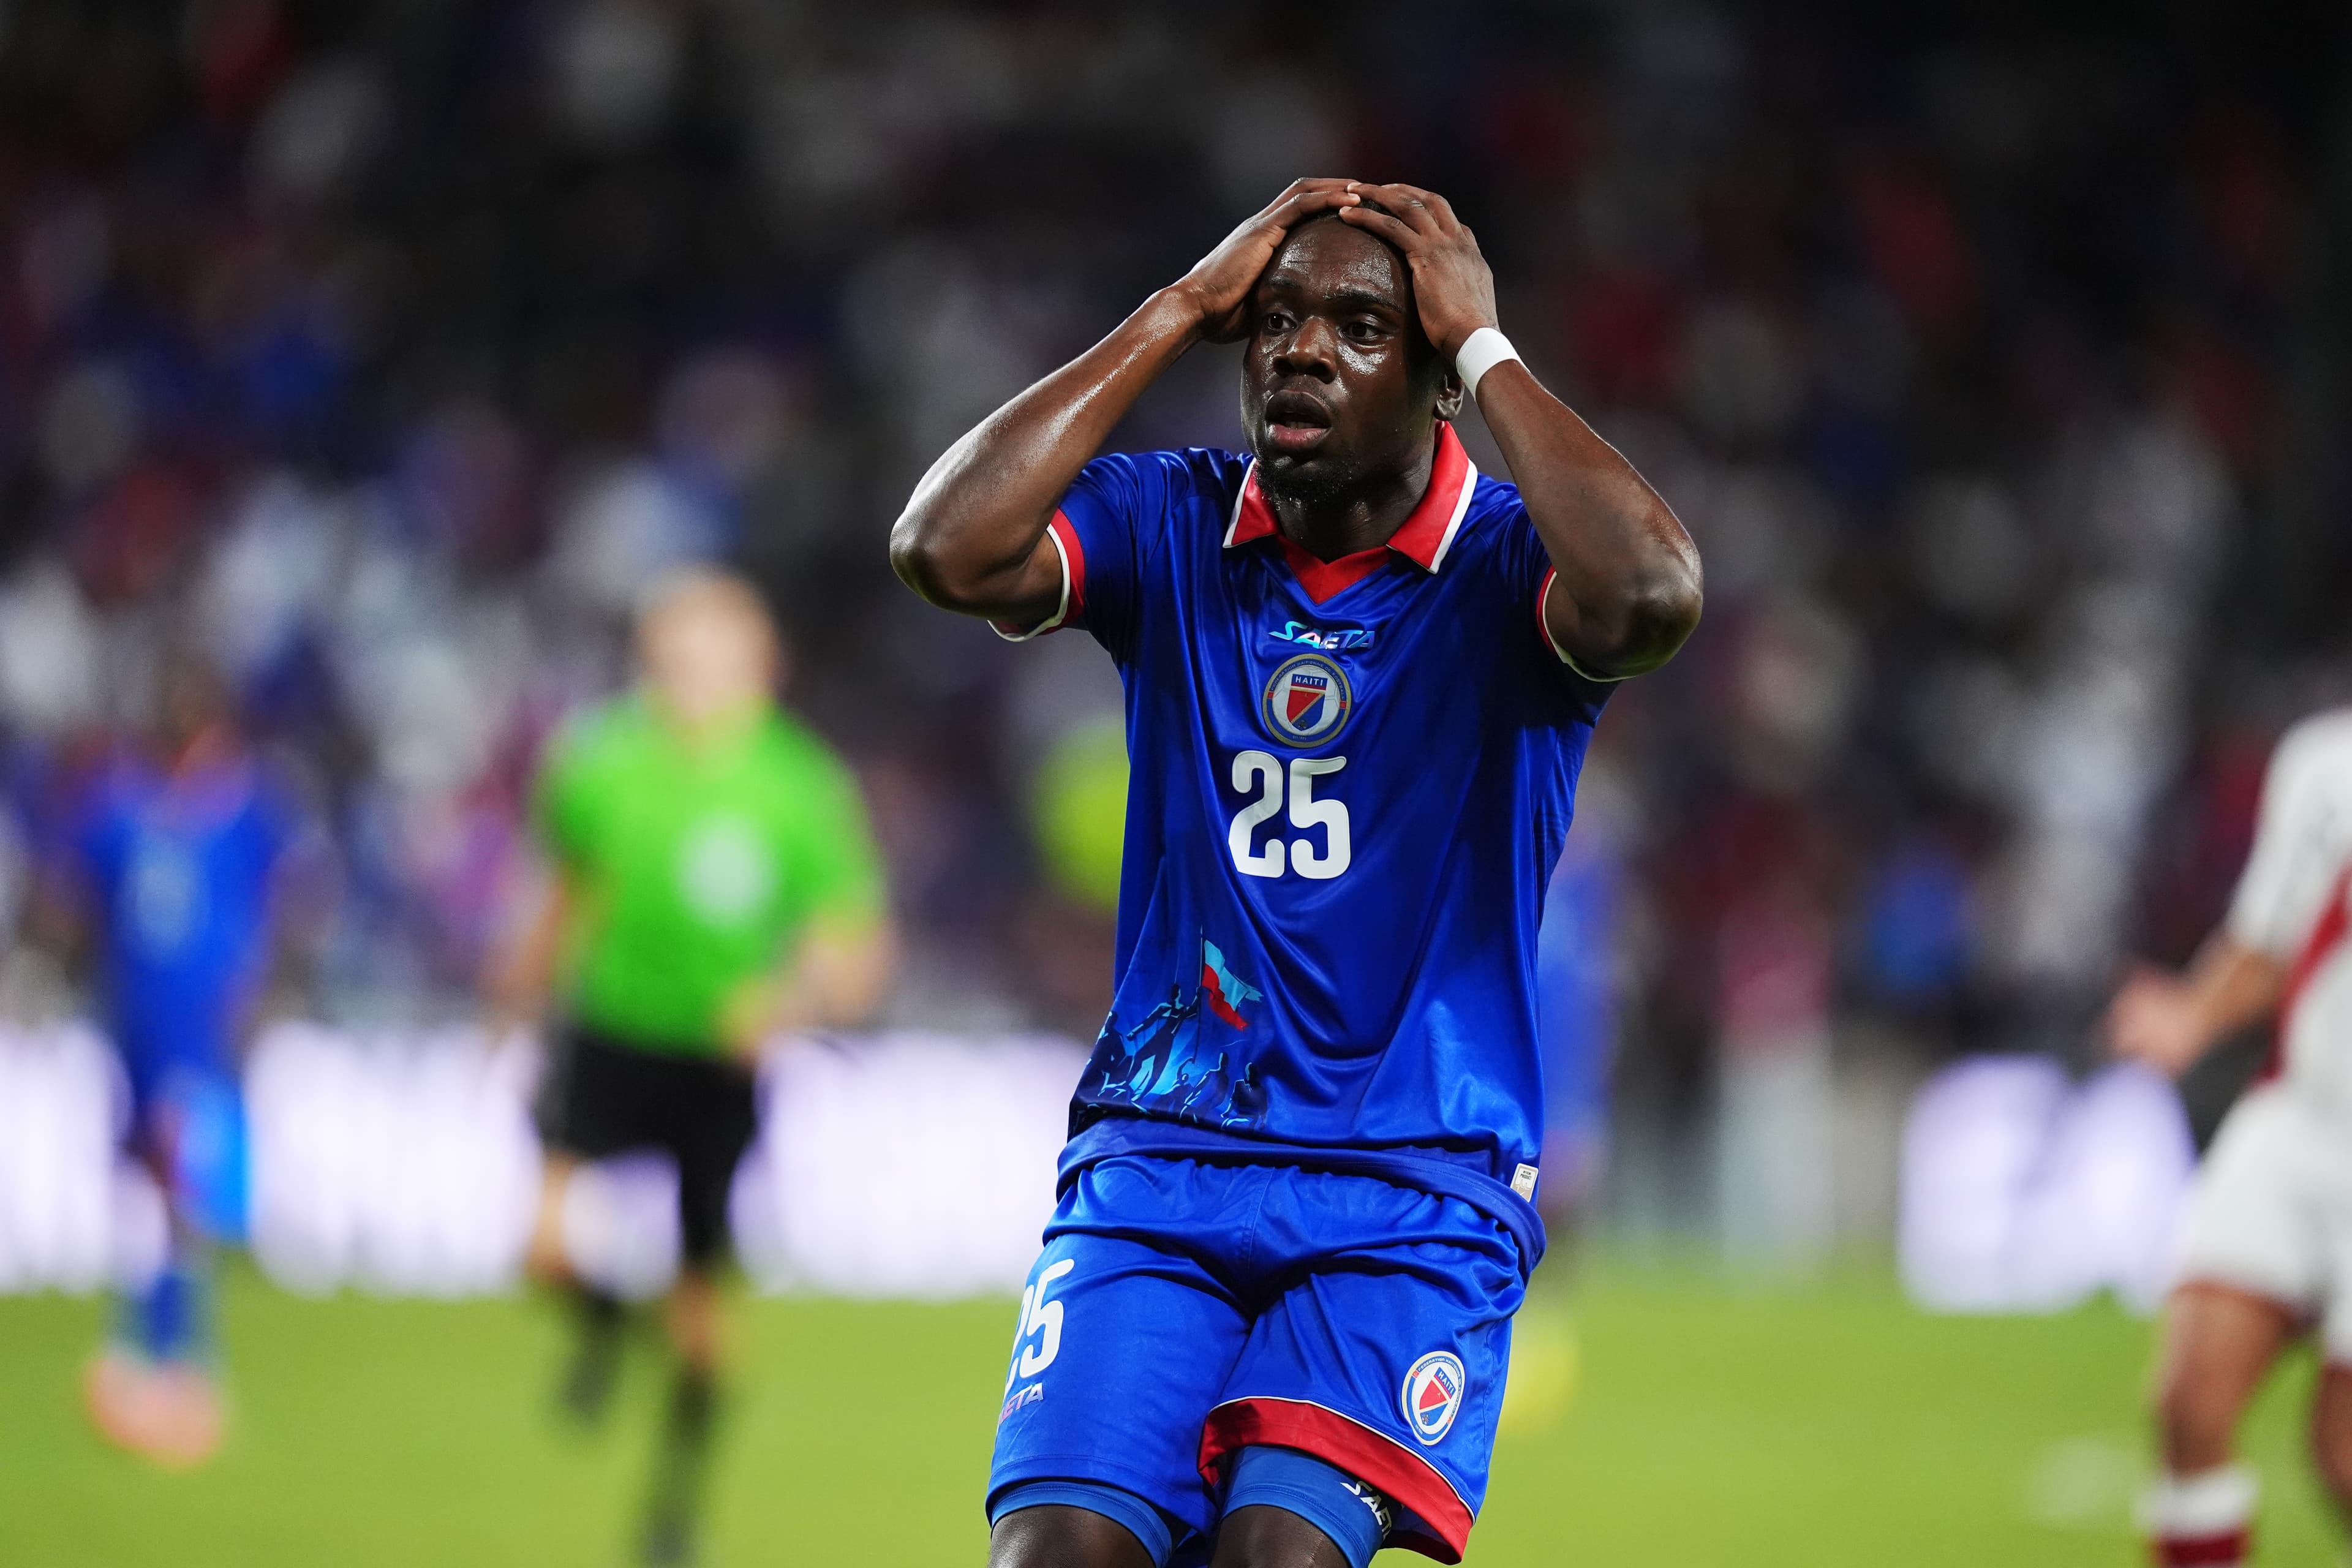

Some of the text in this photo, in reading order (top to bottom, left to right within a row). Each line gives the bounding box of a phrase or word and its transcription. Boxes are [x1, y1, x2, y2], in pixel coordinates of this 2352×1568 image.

[1268, 620, 1376, 649] SAETA
[1295, 676, 1324, 686] HAITI
[1229, 750, 1351, 879] 25
[1438, 1371, 1455, 1394] HAITI
[998, 1382, 1044, 1425] ETA
[1340, 1480, 1392, 1540] SAET
